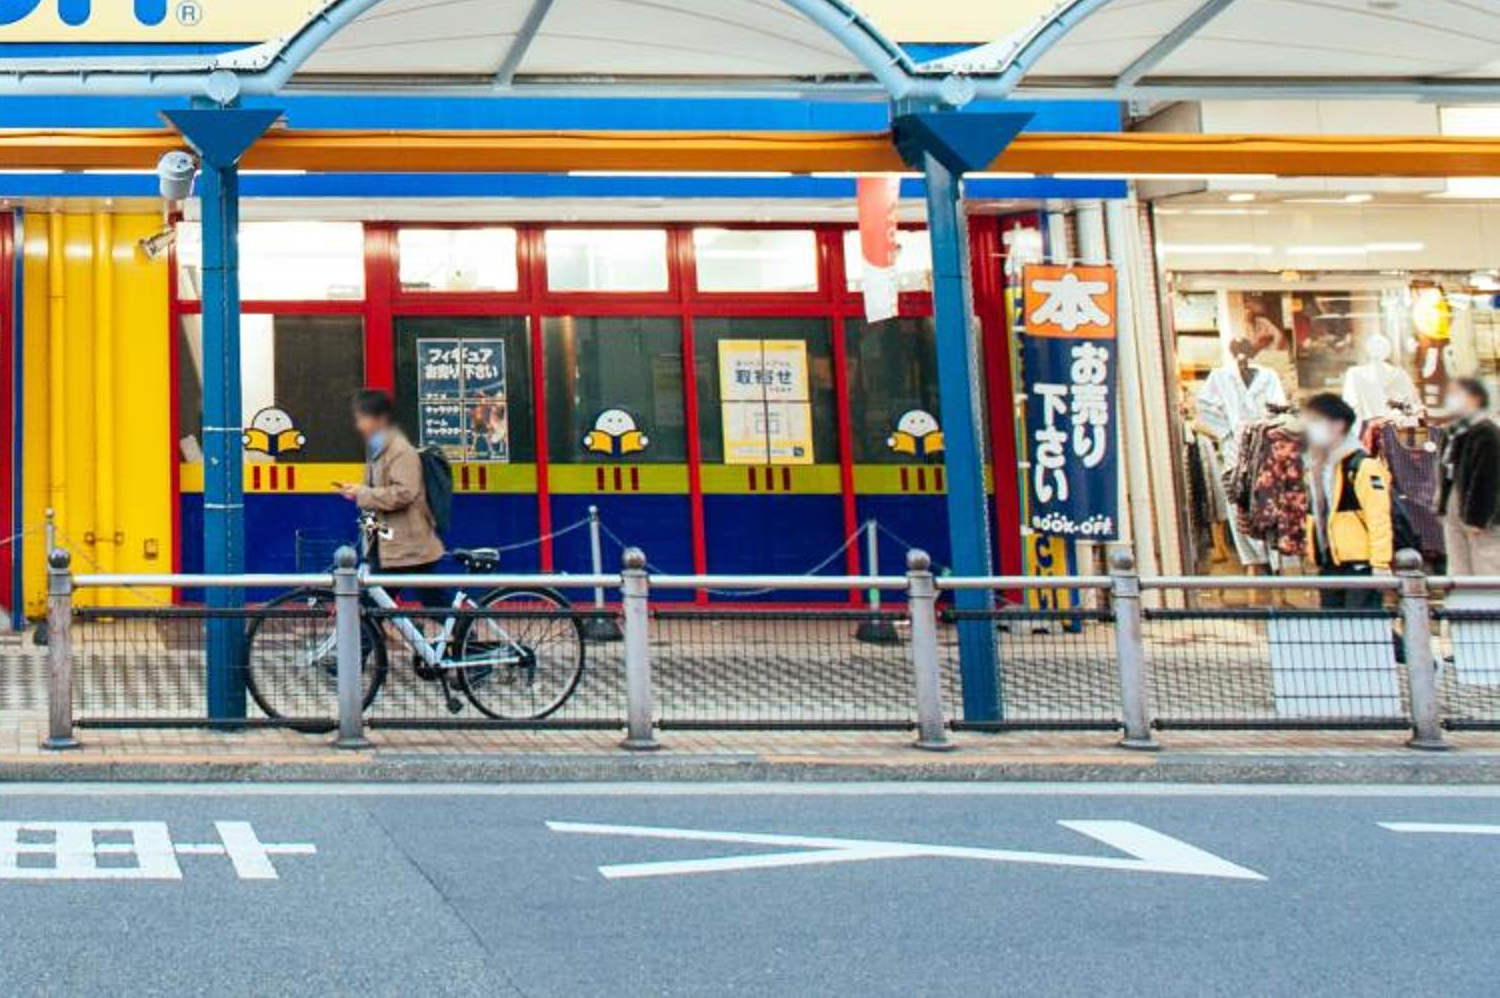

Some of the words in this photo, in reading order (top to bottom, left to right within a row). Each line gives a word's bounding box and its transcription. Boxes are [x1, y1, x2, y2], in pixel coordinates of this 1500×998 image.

[1030, 273, 1110, 332] 本
[428, 347, 493, 363] フィギュア
[1033, 383, 1069, 502] 下さい
[1071, 341, 1109, 469] お売り
